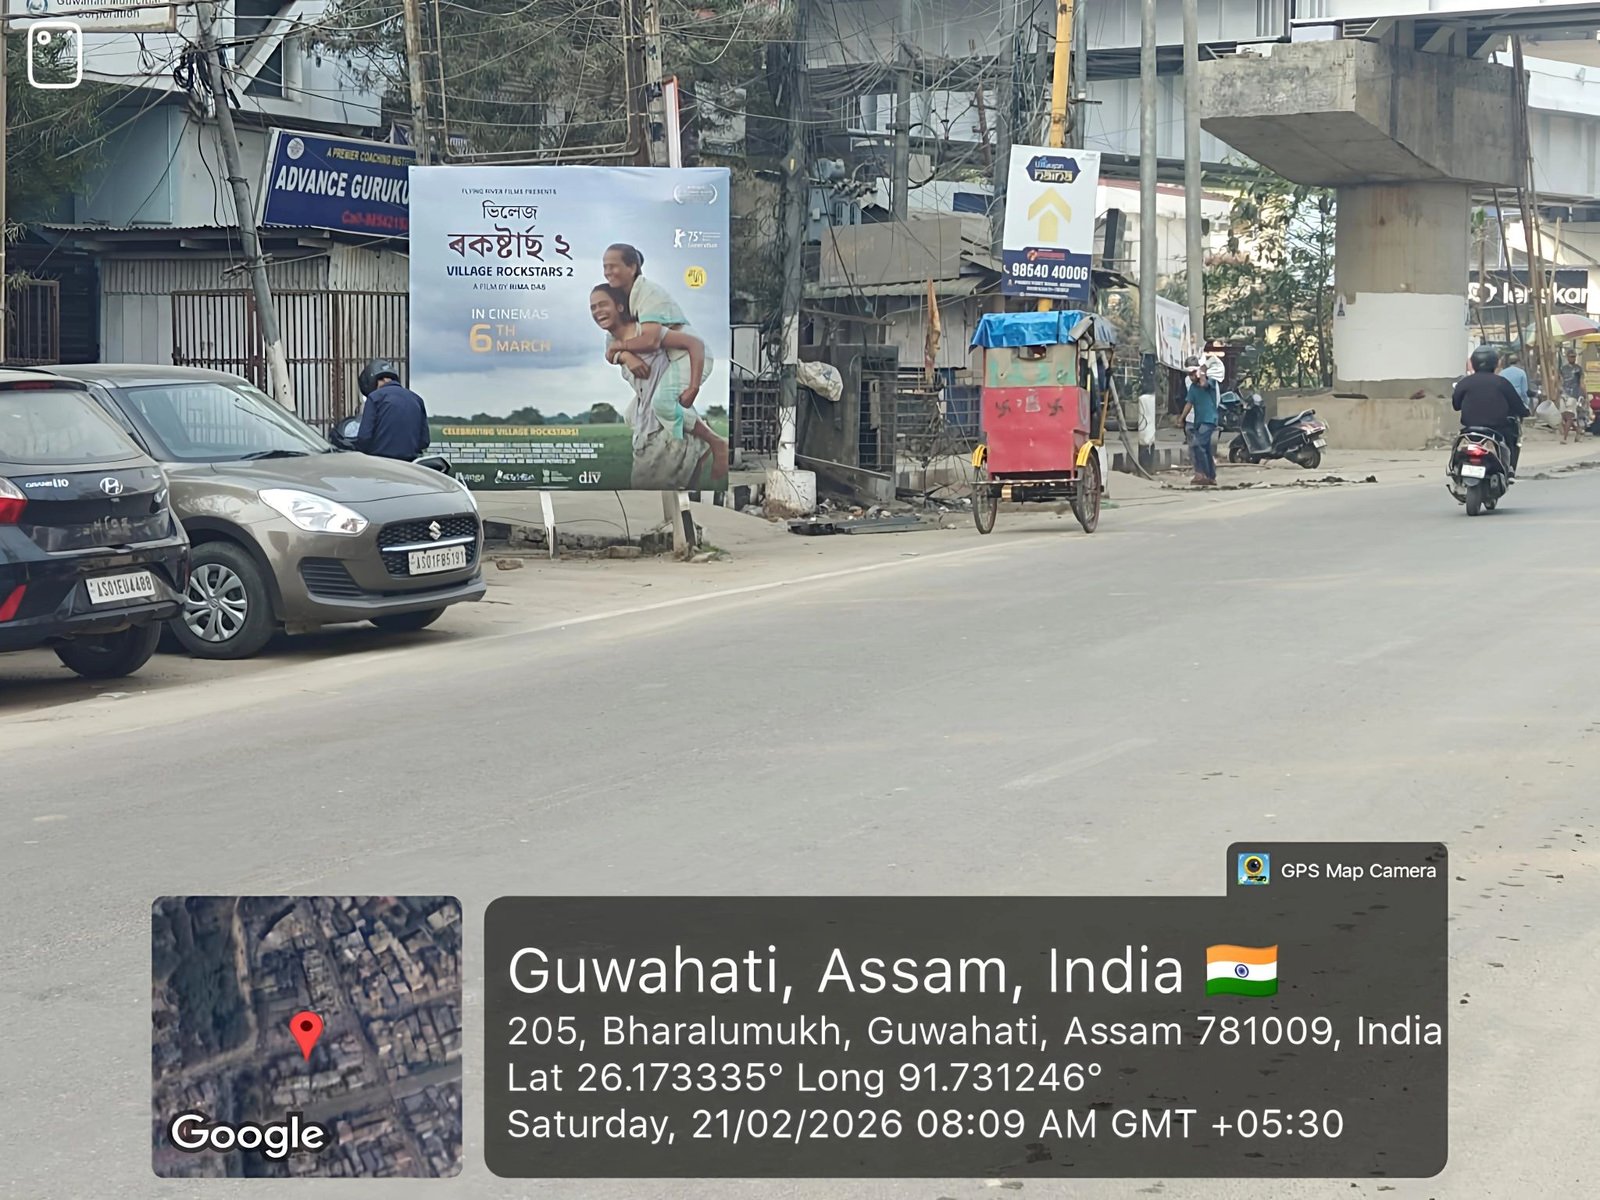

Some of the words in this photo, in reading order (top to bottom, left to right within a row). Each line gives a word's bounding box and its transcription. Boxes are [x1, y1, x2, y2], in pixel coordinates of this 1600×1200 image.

[275, 165, 348, 197] ADVANCE
[482, 199, 538, 220] ভিলেজ
[555, 234, 573, 260] ২
[446, 266, 493, 277] VILLAGE
[496, 266, 563, 277] ROCKSTARS
[566, 266, 574, 277] 2
[1051, 264, 1088, 280] 40006
[471, 308, 485, 320] IN
[488, 308, 550, 320] CINEMAS
[469, 323, 492, 353] 6
[495, 324, 516, 337] TH
[496, 340, 551, 353] MARCH
[442, 427, 495, 437] CELEBRATING
[496, 427, 529, 437] VILLAGE
